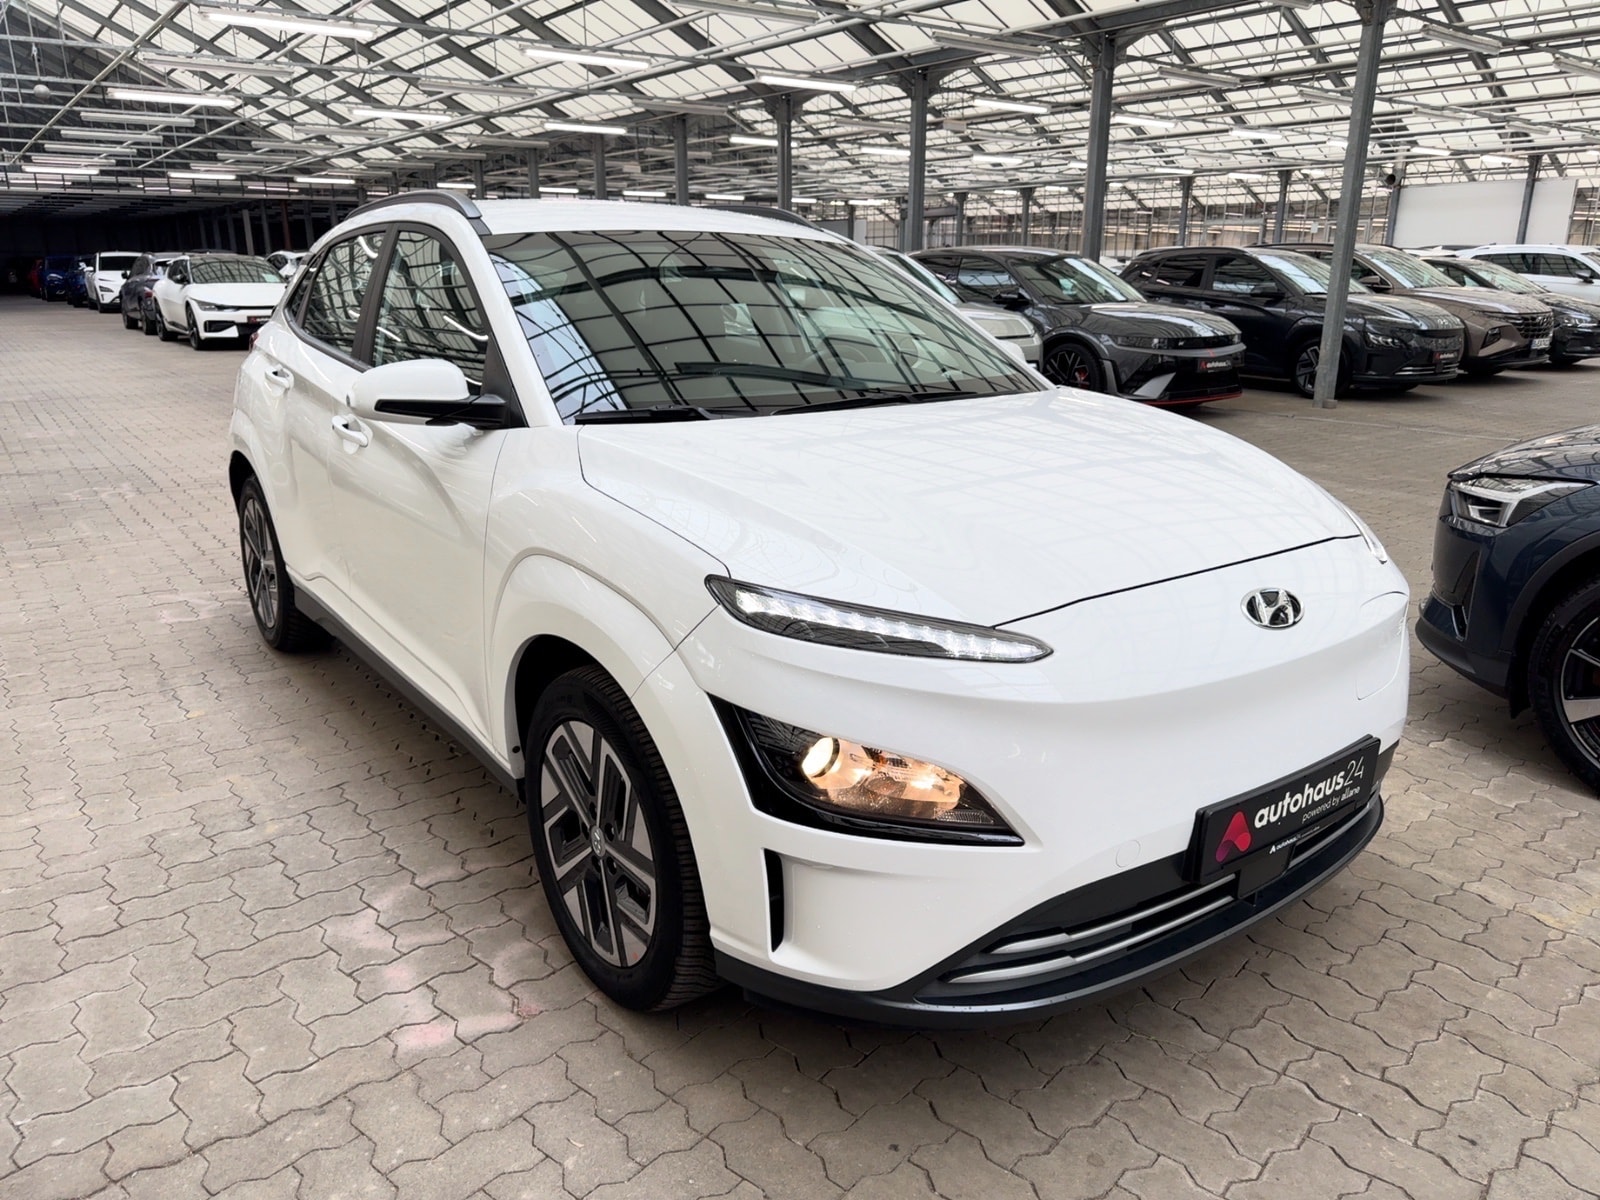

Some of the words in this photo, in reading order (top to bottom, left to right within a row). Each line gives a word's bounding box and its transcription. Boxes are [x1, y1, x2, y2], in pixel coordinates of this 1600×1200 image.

[1254, 756, 1365, 829] autohaus24
[1302, 798, 1332, 824] powered
[1332, 795, 1341, 807] by
